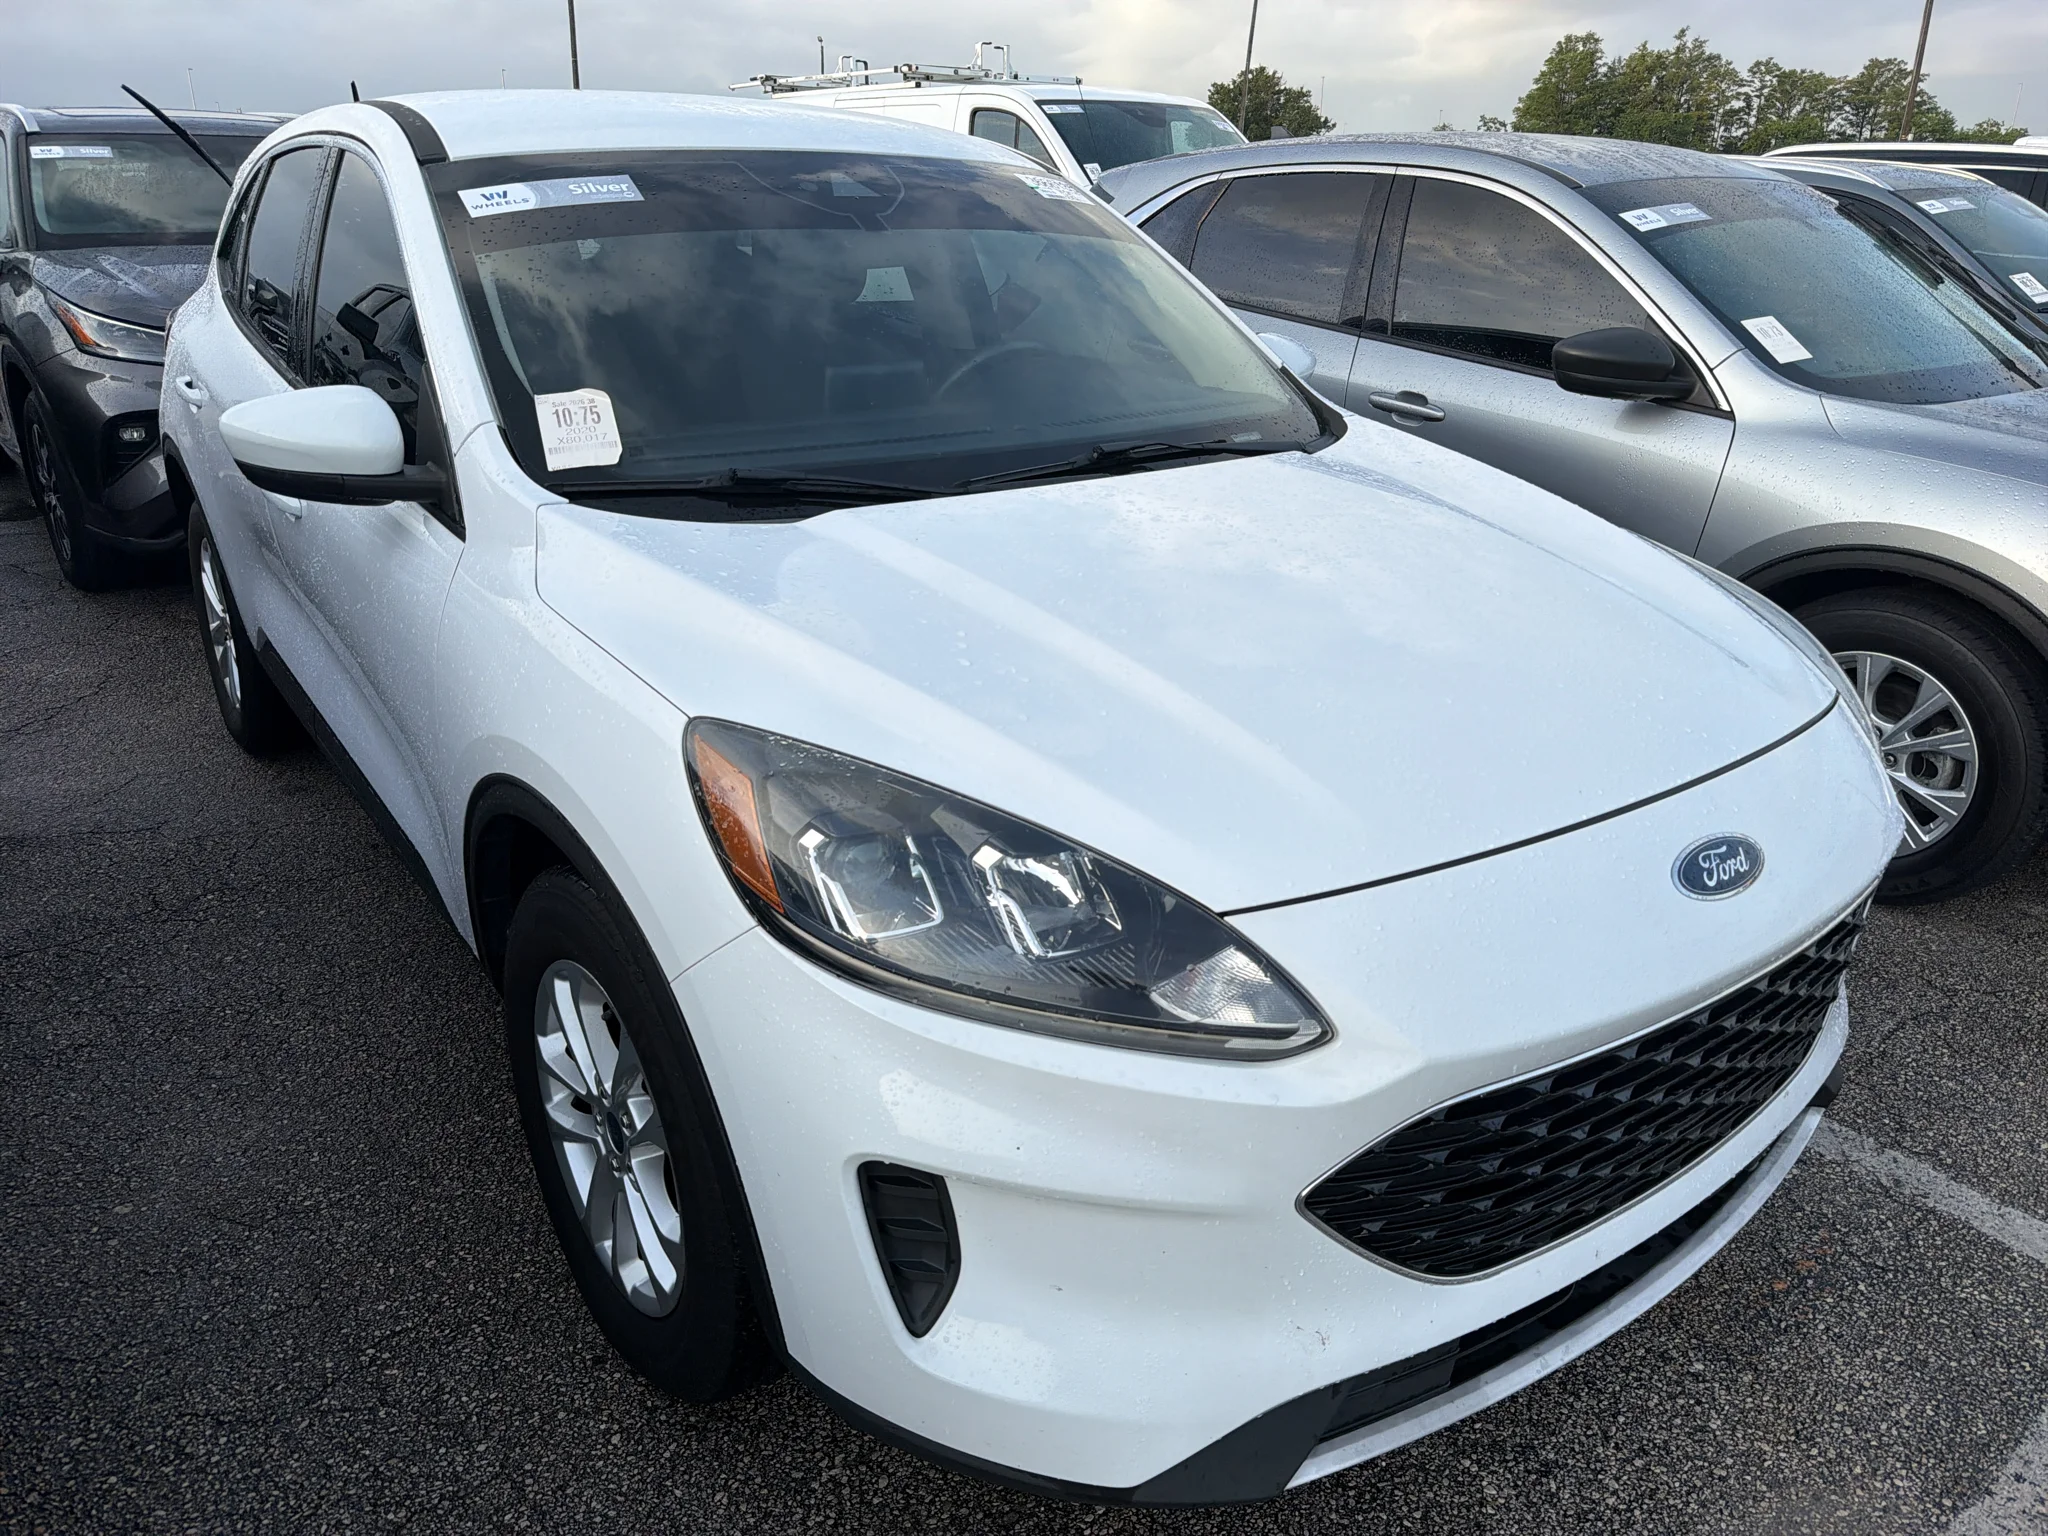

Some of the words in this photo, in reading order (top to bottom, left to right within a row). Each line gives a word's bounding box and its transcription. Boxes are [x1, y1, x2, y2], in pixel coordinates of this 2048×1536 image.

[568, 182, 629, 195] Silver
[471, 198, 530, 211] WHEELS
[551, 405, 602, 428] 10:75
[565, 426, 597, 436] 2020
[1698, 845, 1750, 887] Ford
